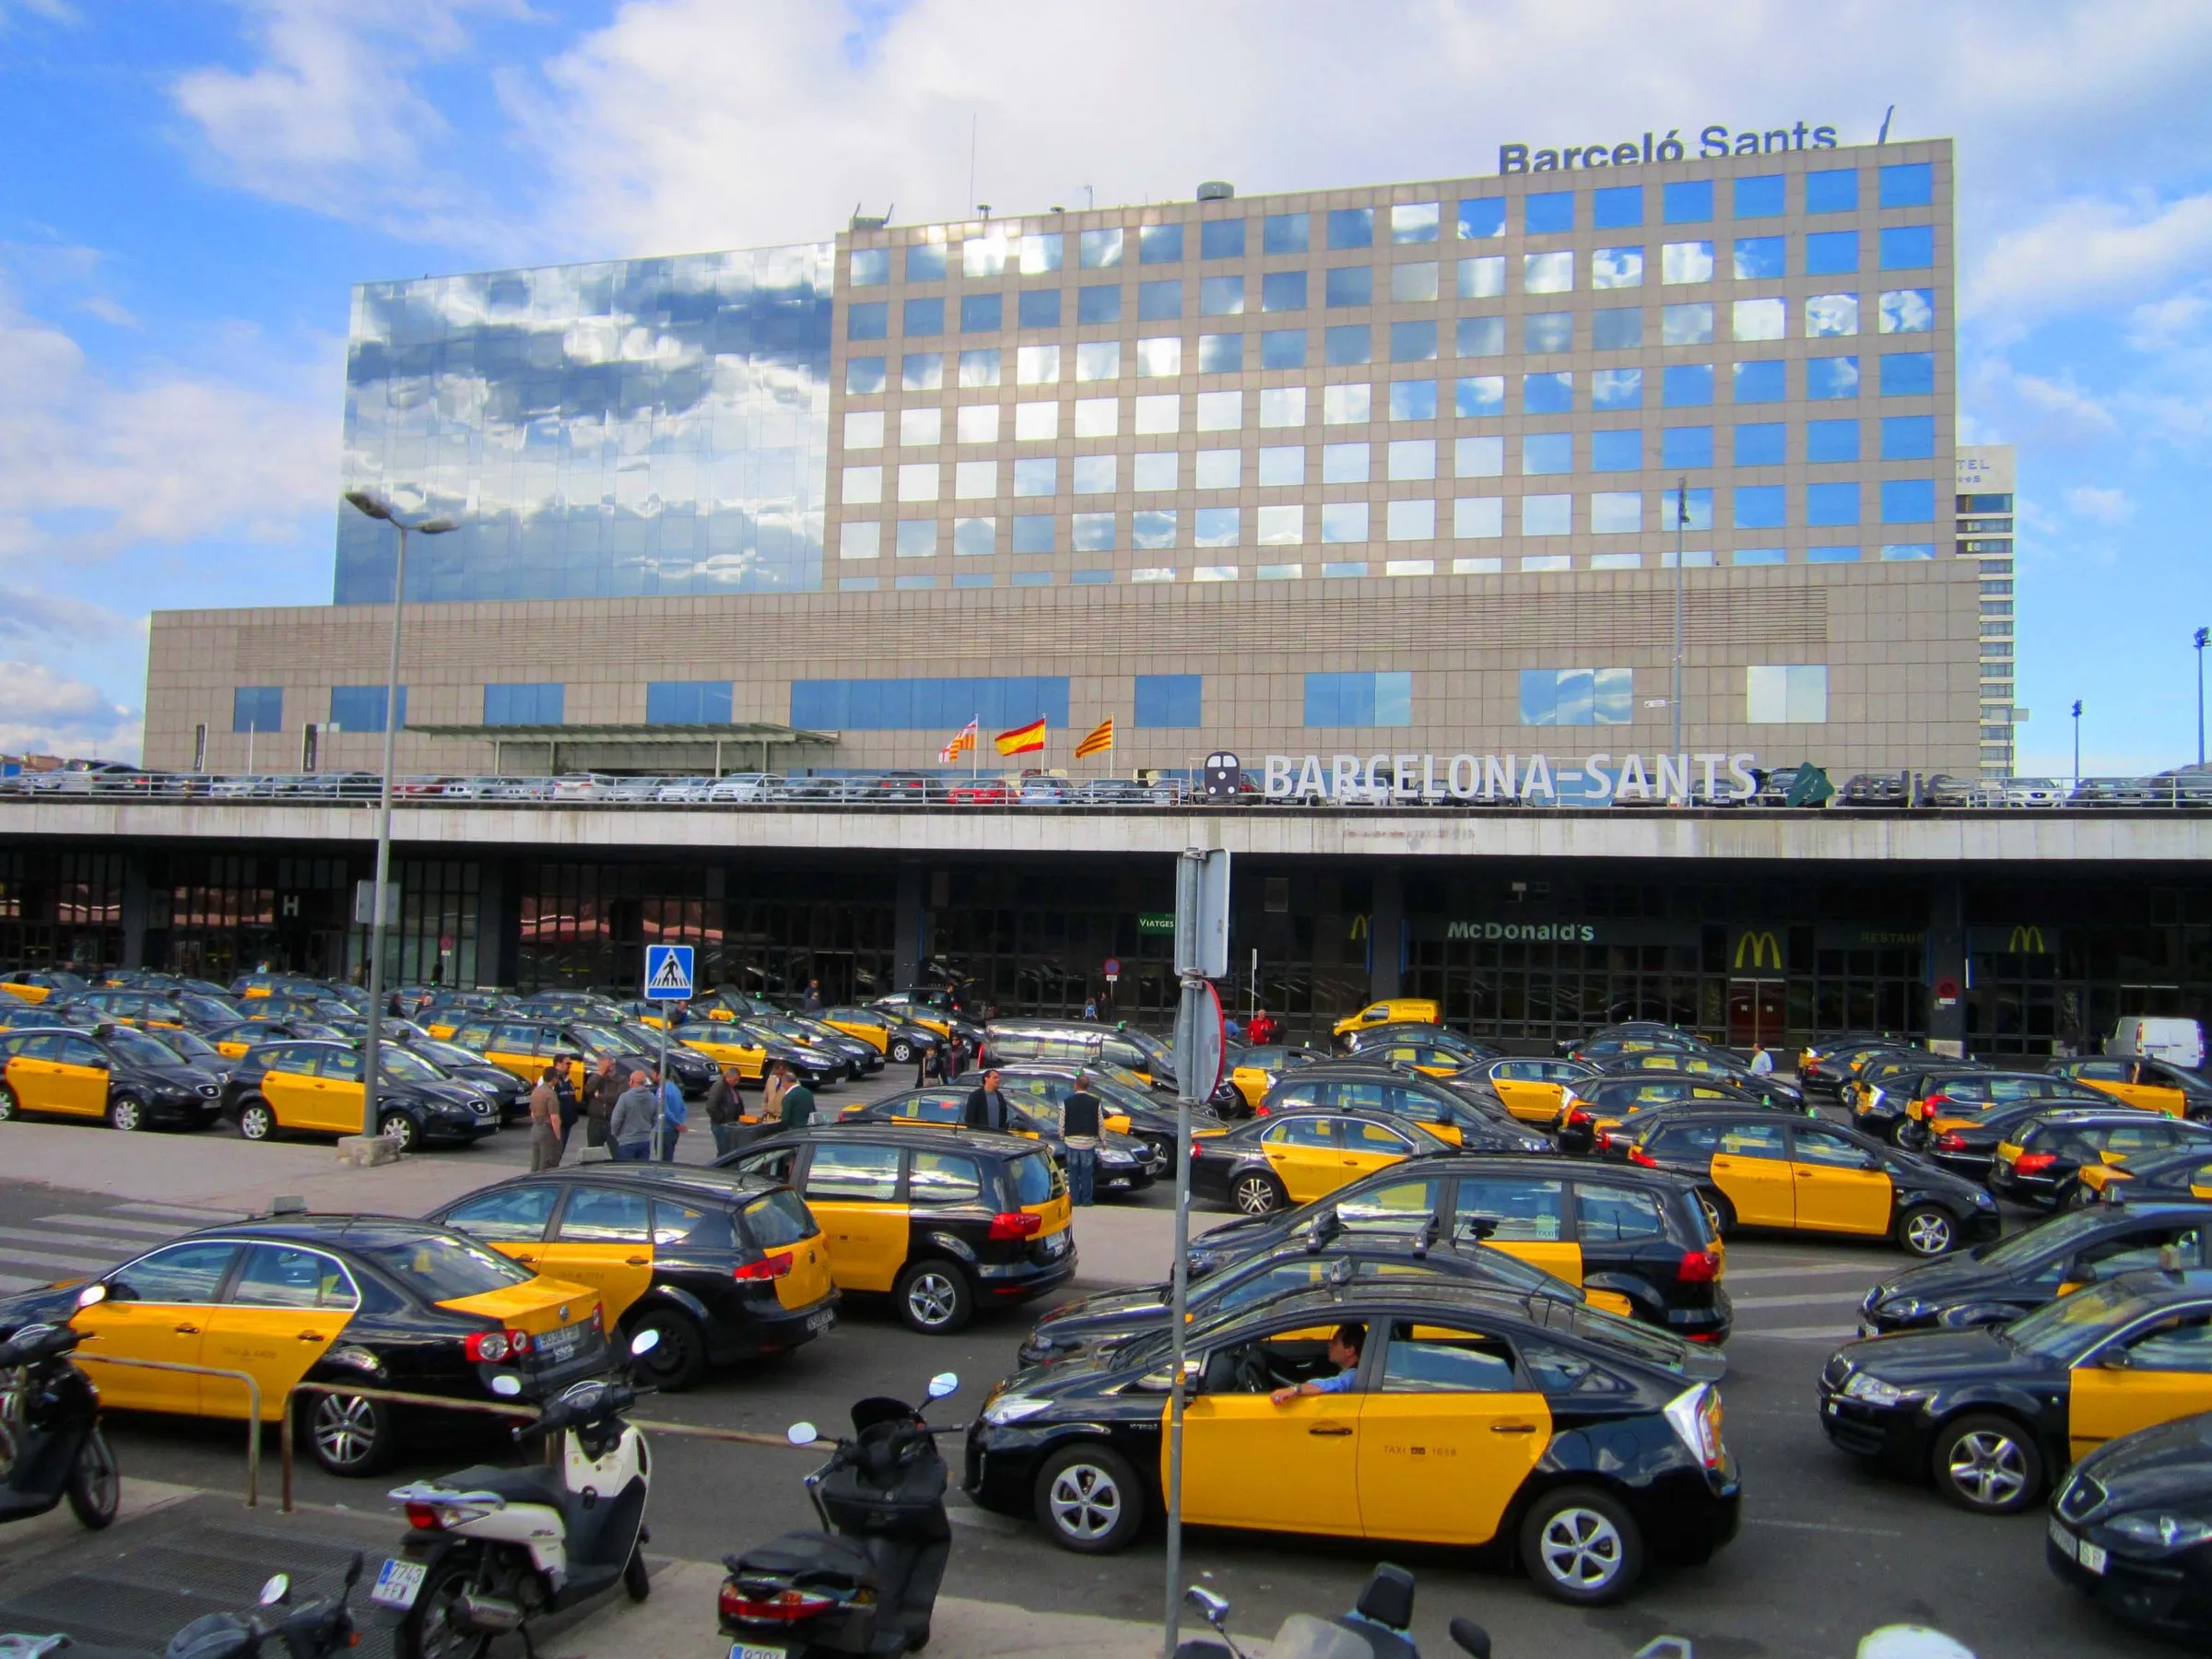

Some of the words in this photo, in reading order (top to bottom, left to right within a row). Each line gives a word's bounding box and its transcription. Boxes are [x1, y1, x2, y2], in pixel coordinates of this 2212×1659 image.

[1499, 130, 1684, 175] Barceló
[1700, 121, 1837, 159] Sants
[283, 895, 300, 917] H
[1447, 922, 1594, 941] McDonald's
[1383, 1445, 1406, 1455] TAXI
